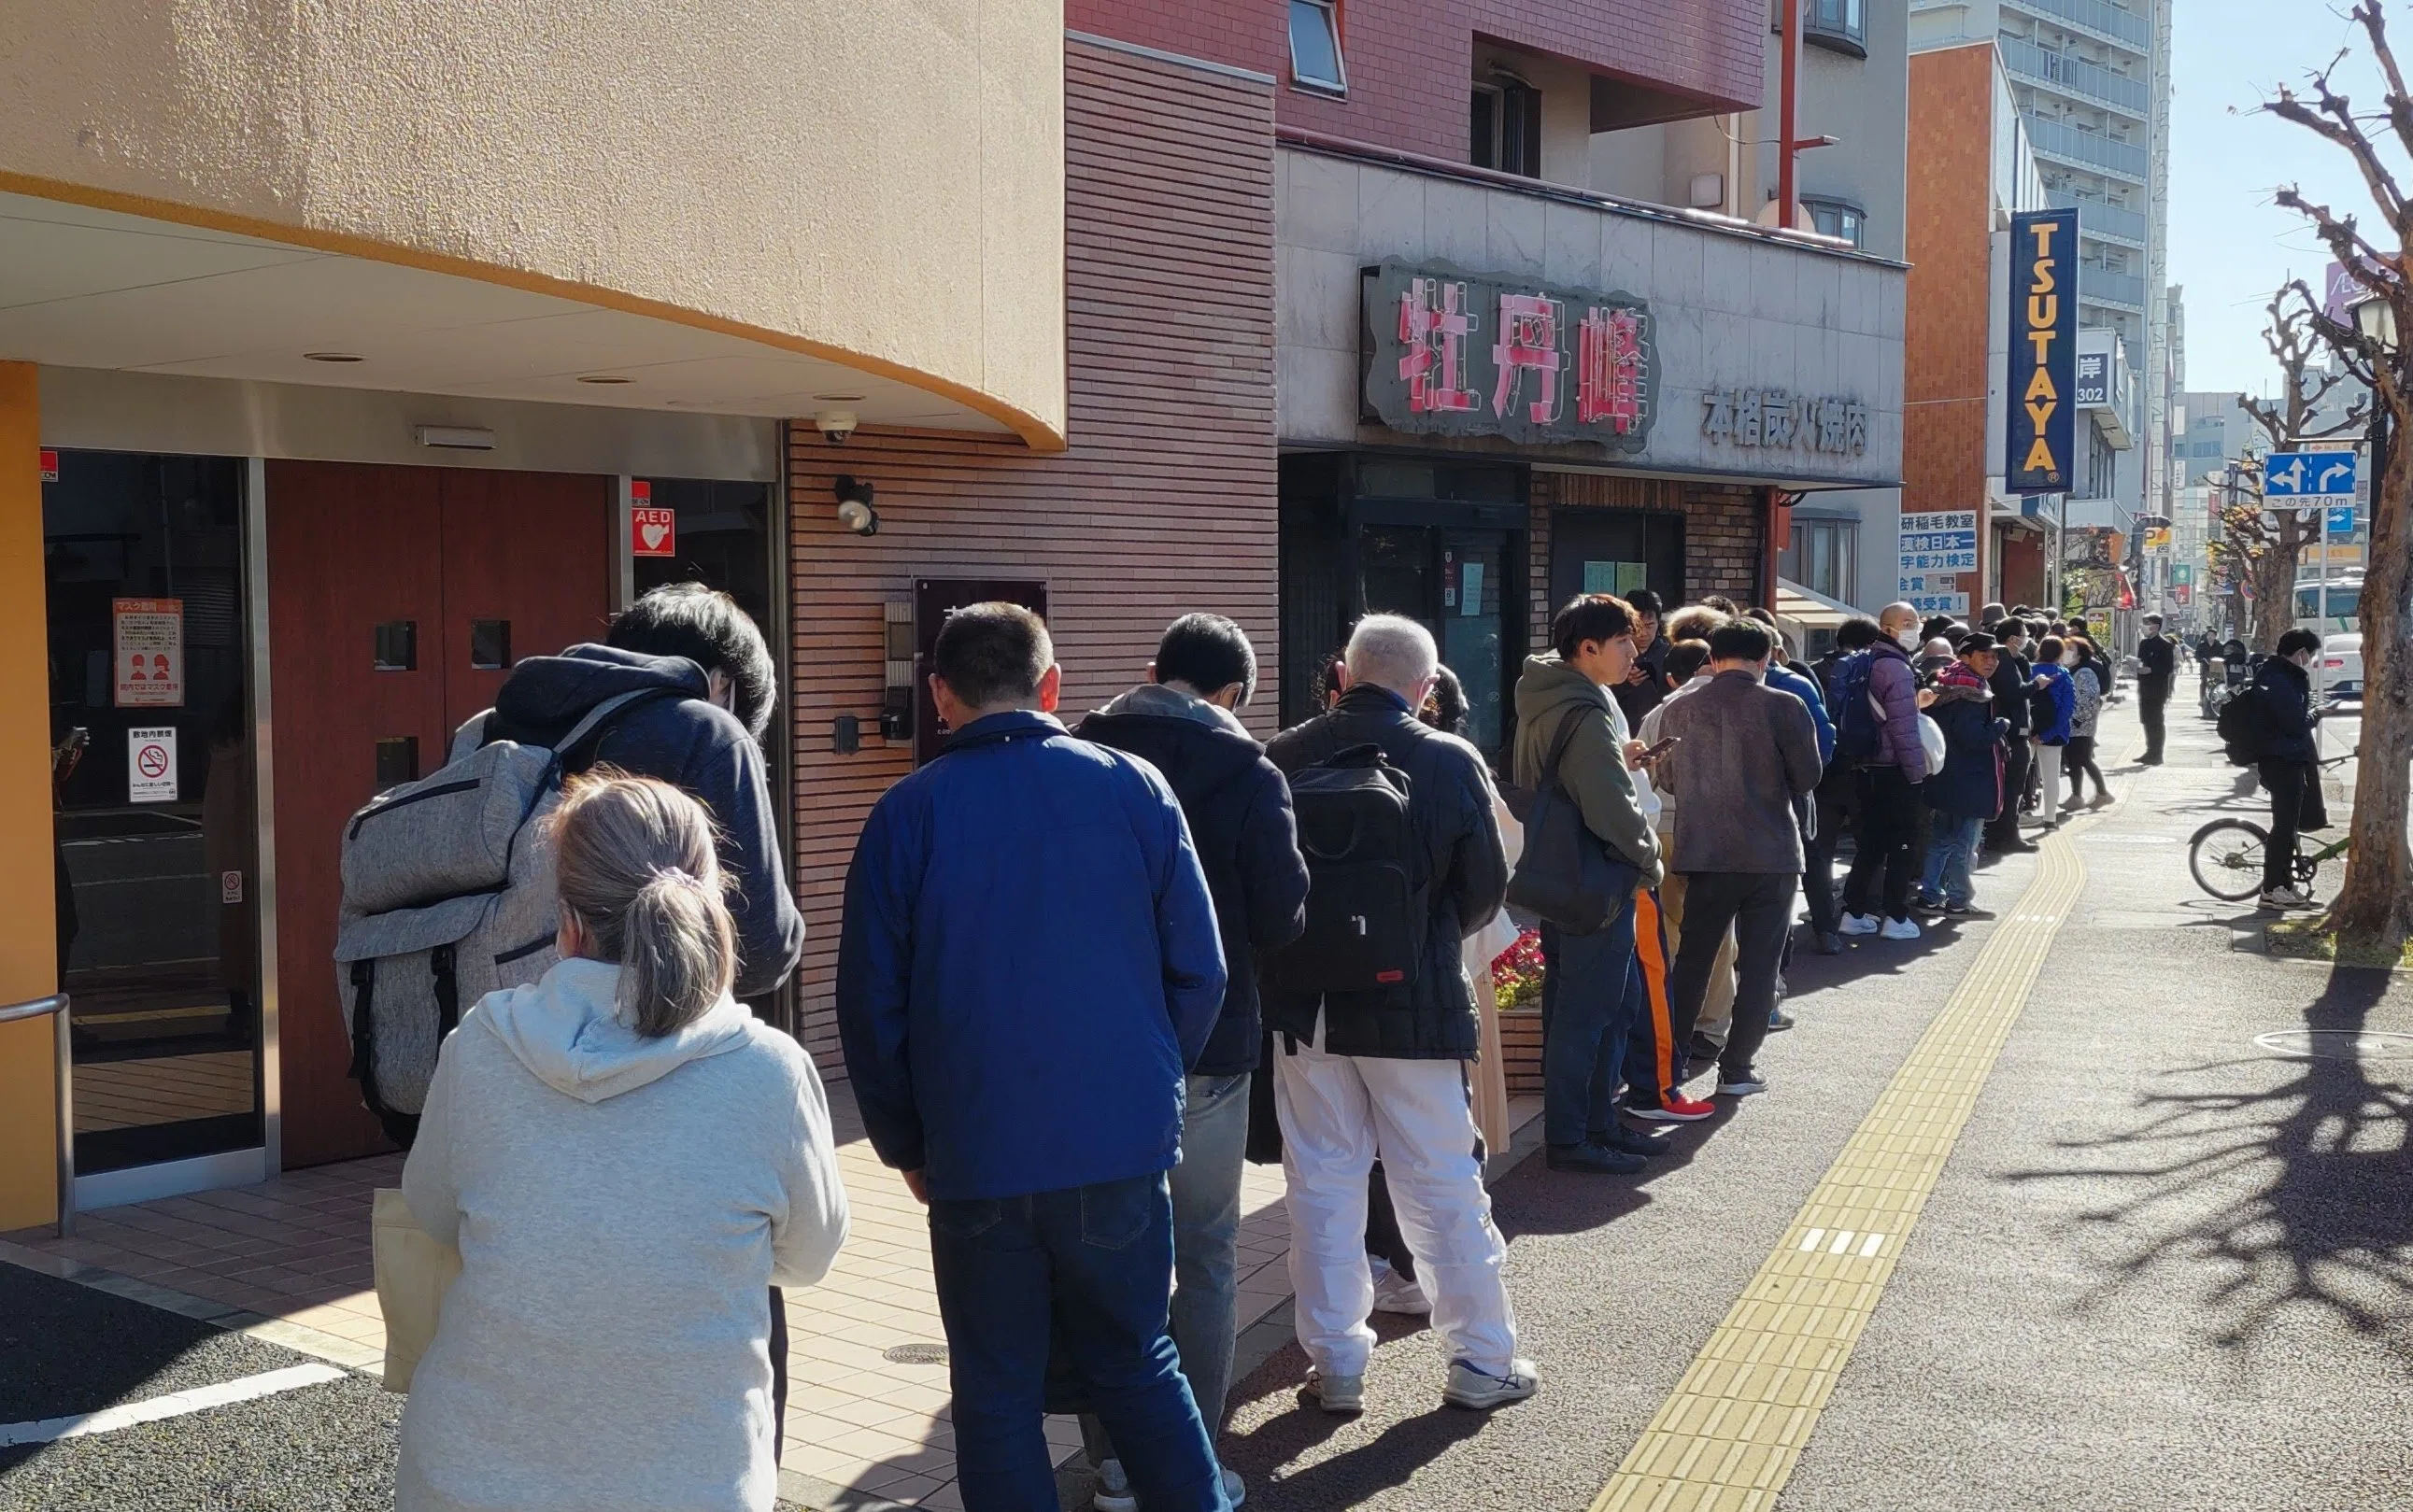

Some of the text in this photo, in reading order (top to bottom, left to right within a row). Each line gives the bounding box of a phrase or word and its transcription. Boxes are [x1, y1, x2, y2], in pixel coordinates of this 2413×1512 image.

[1398, 277, 1649, 434] 牡丹峰
[2023, 223, 2058, 472] TSUTAYA
[2079, 358, 2101, 379] 岸
[2078, 388, 2103, 402] 302
[1703, 389, 1867, 456] 本格炭火焼肉
[2271, 496, 2348, 507] この先70m
[635, 511, 671, 523] AED
[1901, 515, 1974, 530] 研稲毛教室
[1901, 534, 1975, 551] 漢検日本一
[1901, 553, 1975, 569] 字能力検定
